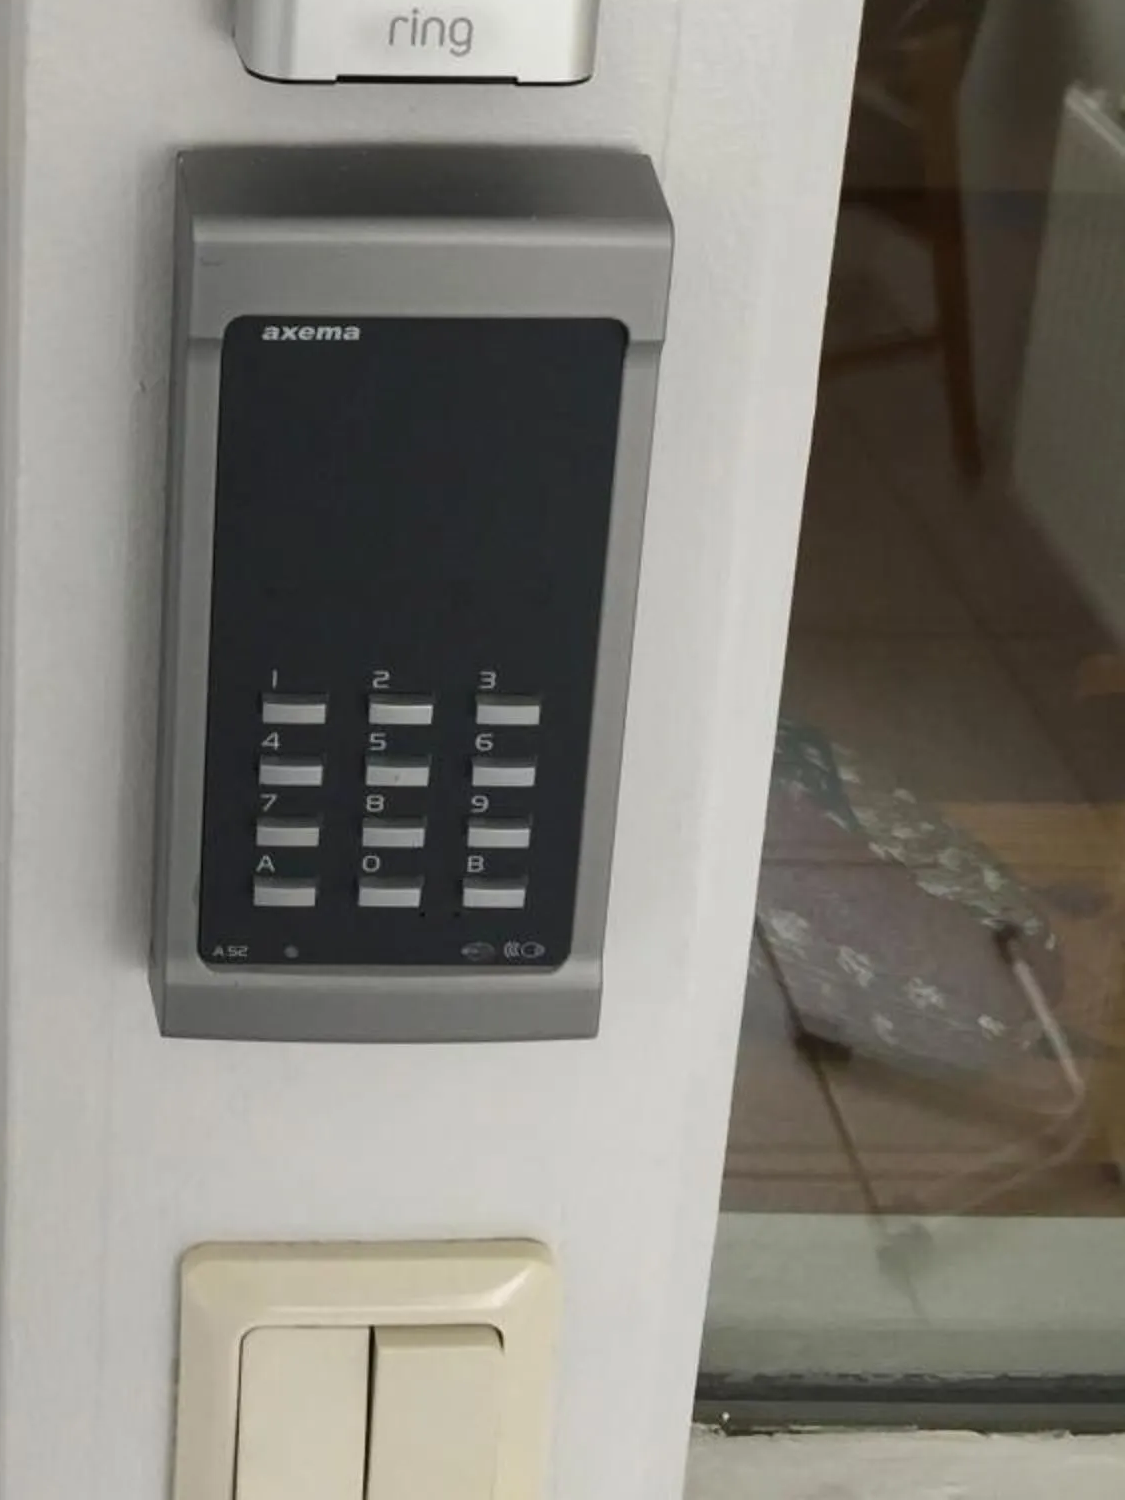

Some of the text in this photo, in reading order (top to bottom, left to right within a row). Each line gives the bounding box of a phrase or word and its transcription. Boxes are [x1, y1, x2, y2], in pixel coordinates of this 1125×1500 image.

[388, 7, 474, 57] ring
[261, 324, 361, 341] axema
[372, 670, 390, 689] 2
[480, 671, 497, 689] 3
[261, 732, 494, 752] 4 5 6
[260, 793, 489, 813] 7 8 9
[256, 855, 276, 872] A
[466, 855, 485, 873] B
